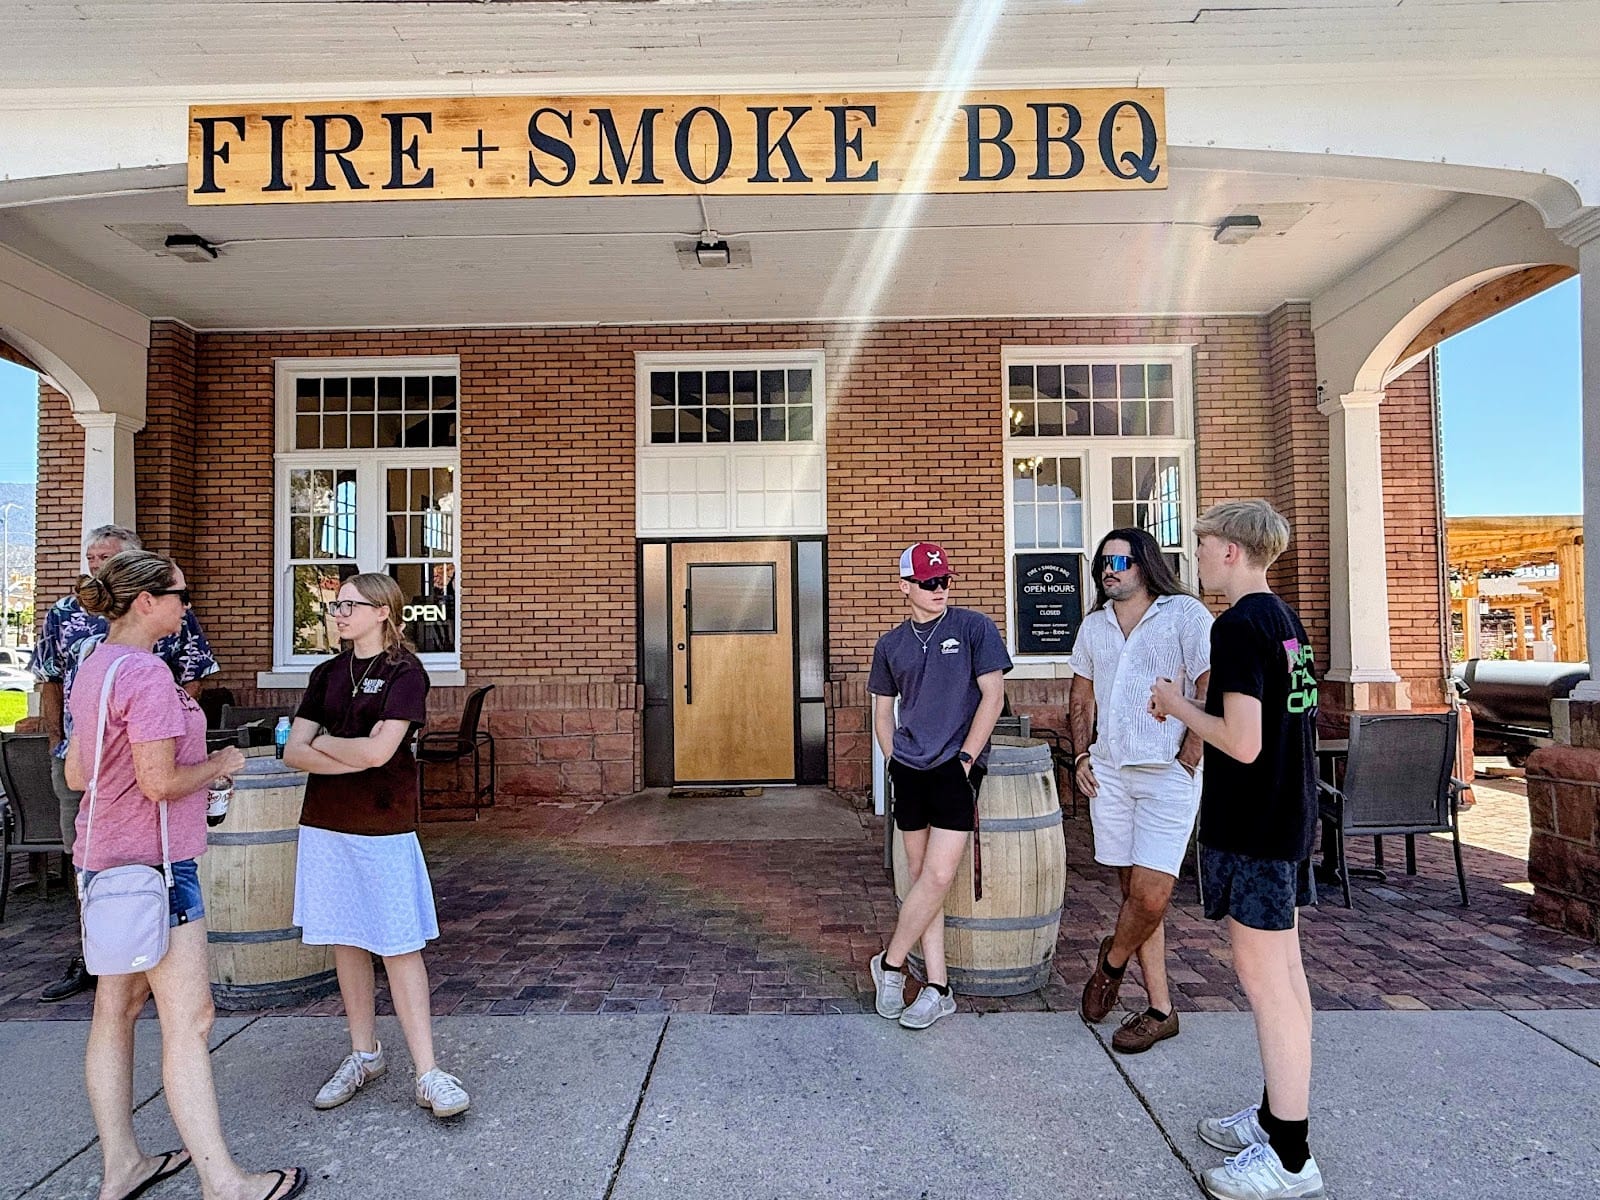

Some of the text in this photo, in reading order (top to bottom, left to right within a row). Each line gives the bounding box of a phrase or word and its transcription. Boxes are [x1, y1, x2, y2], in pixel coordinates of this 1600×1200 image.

[193, 100, 1161, 194] FIRE + SMOKE BBQ
[1023, 585, 1075, 593] OPEN HOURS
[402, 604, 447, 622] OPEN
